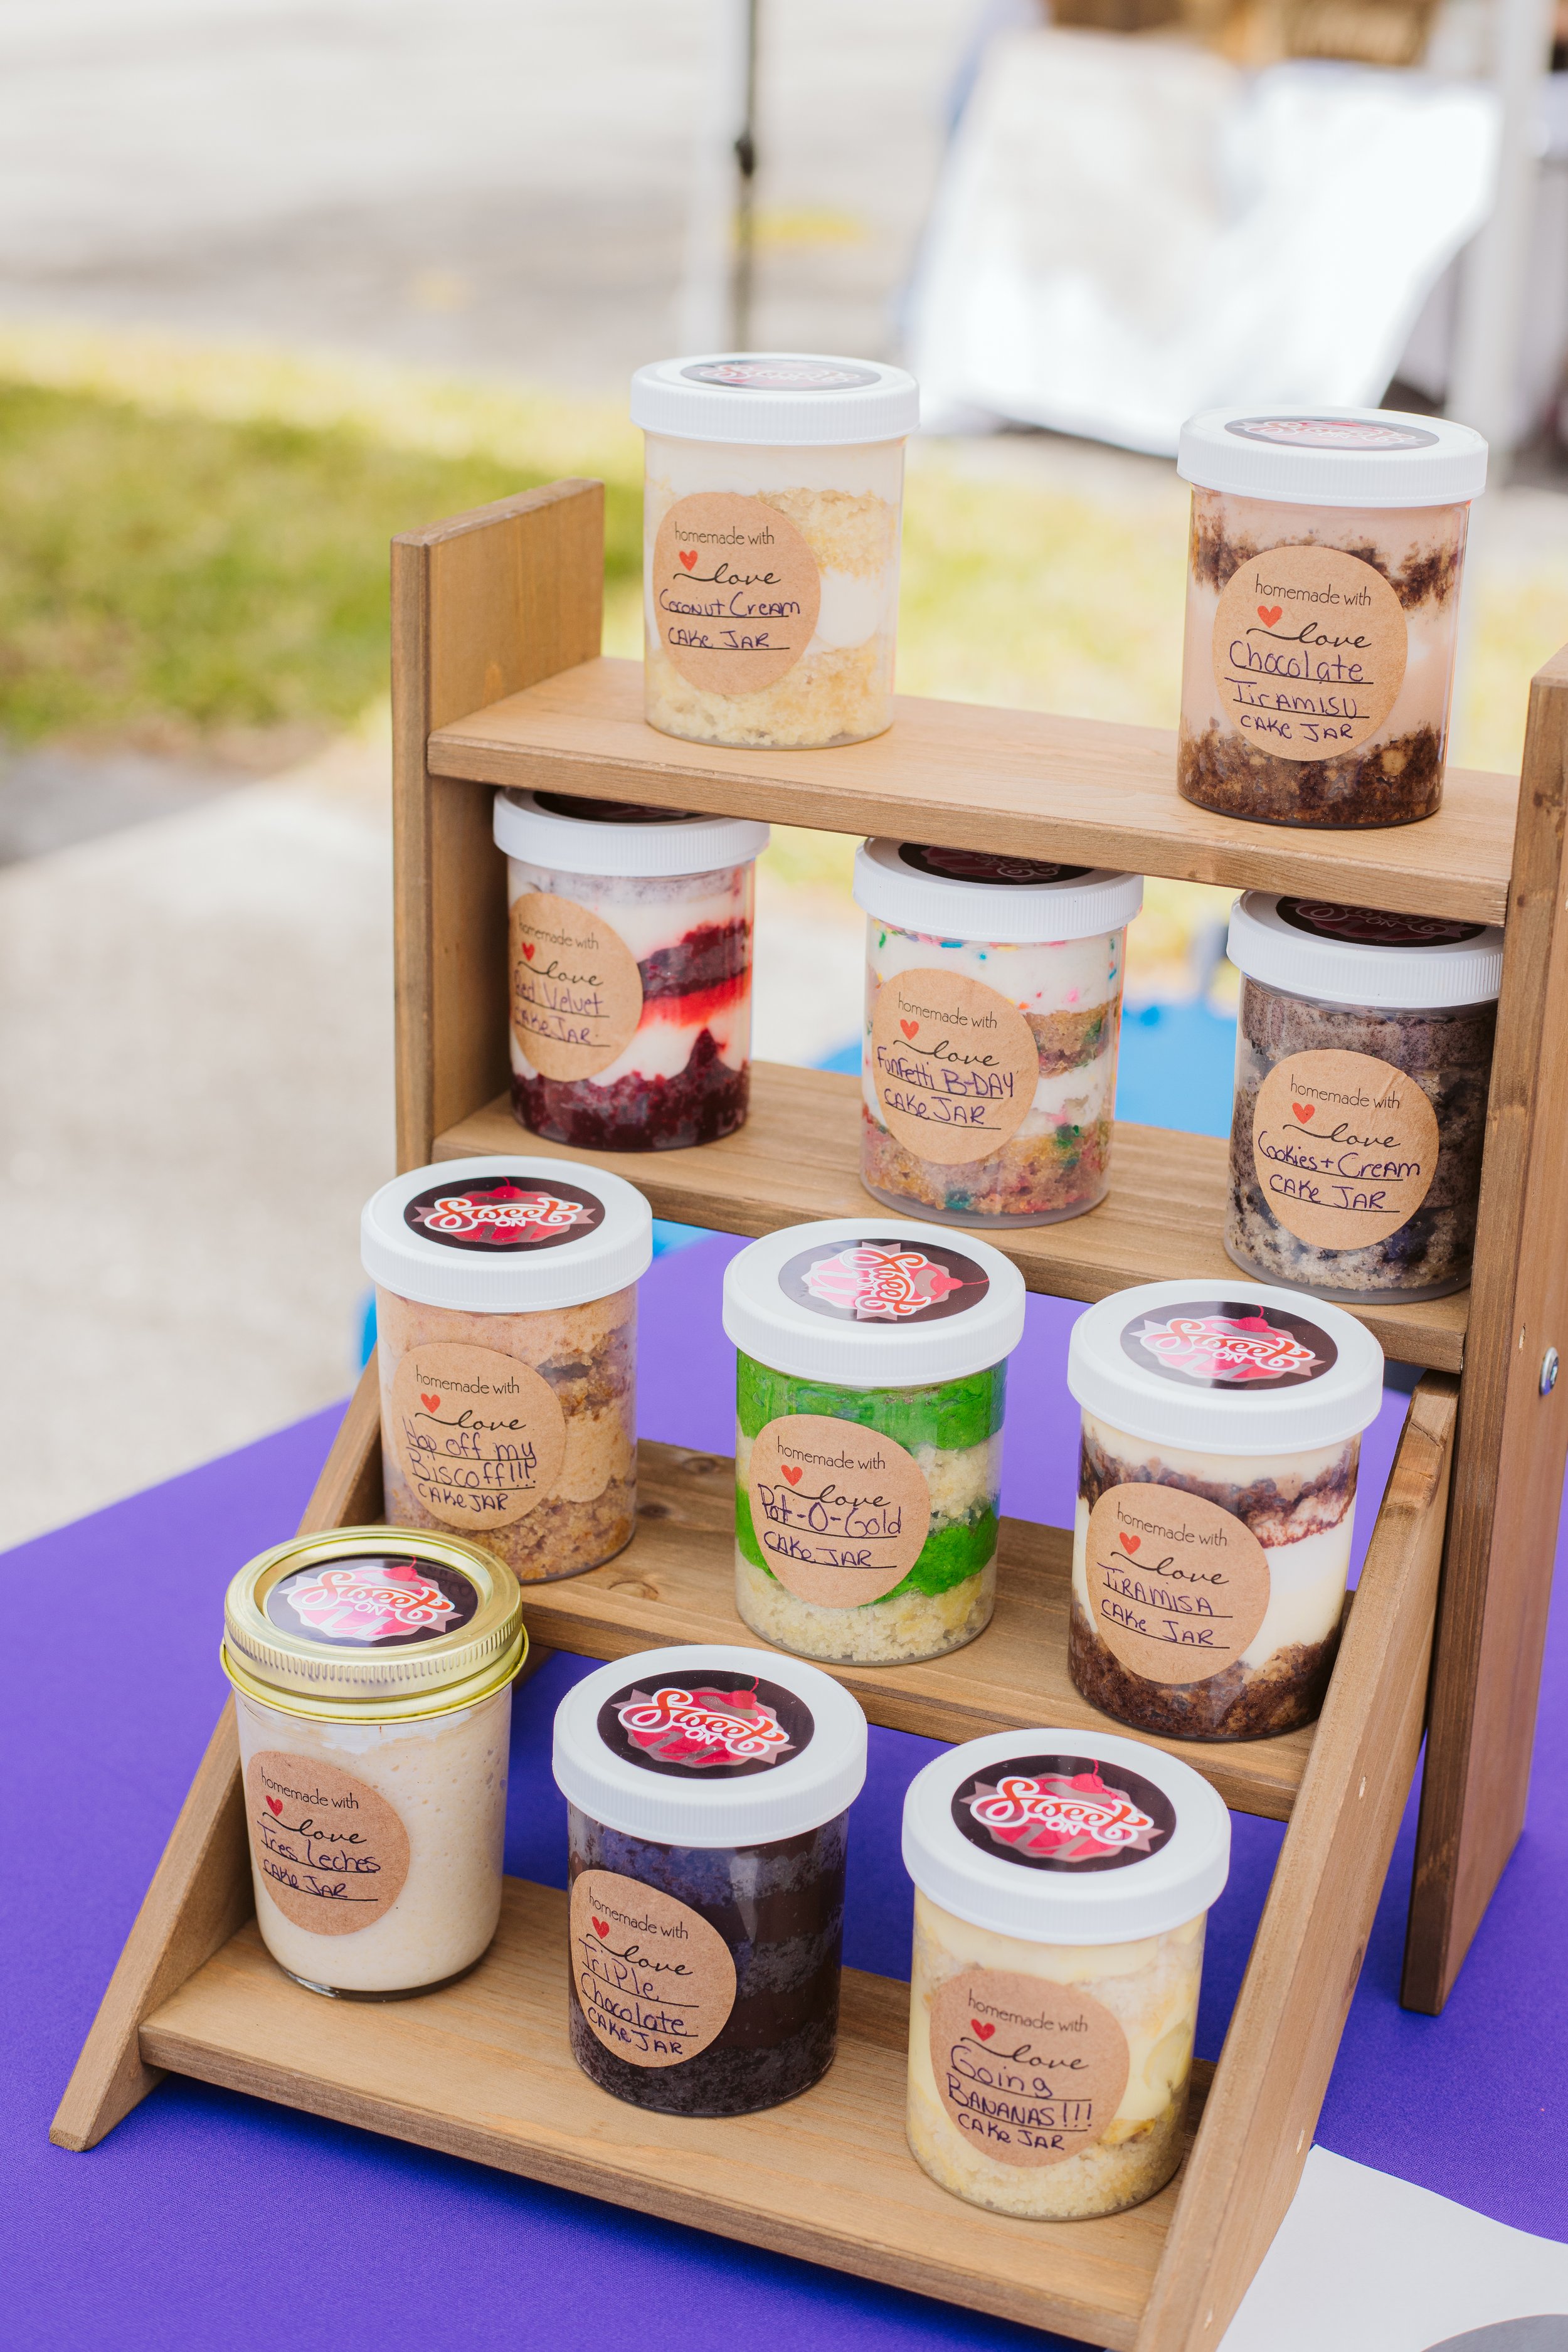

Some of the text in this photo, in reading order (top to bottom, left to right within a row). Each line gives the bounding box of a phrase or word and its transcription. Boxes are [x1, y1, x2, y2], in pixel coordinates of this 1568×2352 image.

[675, 521, 774, 544] homemade with
[674, 563, 781, 585] love
[1256, 573, 1371, 606] homemade with
[720, 630, 769, 649] JAR
[1246, 622, 1372, 648] love
[1230, 640, 1363, 682] Chocolate
[1300, 724, 1353, 742] JAR
[519, 914, 598, 950] homemade with
[518, 961, 603, 986] love
[899, 992, 997, 1028] homemade with
[549, 1015, 591, 1044] JAR
[893, 1041, 1000, 1066] love
[941, 1069, 1014, 1097] B-DAY
[1291, 1074, 1400, 1109] homemade with
[931, 1096, 985, 1125] JAR
[1283, 1123, 1401, 1147] love
[1332, 1185, 1385, 1209] JAR
[424, 1197, 583, 1232] Sweet
[839, 1248, 931, 1315] Sweet
[1140, 1318, 1315, 1371] Sweet
[1212, 1350, 1245, 1363] ON
[416, 1365, 519, 1394] homemade with
[415, 1410, 526, 1431] love
[778, 1436, 885, 1470] homemade with
[470, 1493, 508, 1512] JAR
[774, 1485, 891, 1507] love
[1117, 1502, 1227, 1546] homemade with
[816, 1547, 872, 1567] JAR
[1110, 1552, 1229, 1584] love
[287, 1570, 455, 1624] Sweet
[354, 1602, 386, 1616] ON
[1162, 1620, 1213, 1645] JAR
[618, 1687, 790, 1756] Sweet
[684, 1729, 719, 1745] ON
[261, 1767, 359, 1809] homemade with
[970, 1776, 1154, 1845] Sweet
[262, 1812, 367, 1843] love
[1046, 1819, 1081, 1836] ON
[303, 1875, 347, 1898] JAR
[589, 1887, 688, 1939] homemade with
[586, 1934, 693, 1976] love
[581, 1972, 687, 2036] Chocolate
[968, 1989, 1088, 2032] homemade with
[631, 2030, 683, 2054] JAR
[960, 2037, 1089, 2070] love
[951, 2045, 1053, 2099] Going
[1017, 2130, 1065, 2150] JAR
